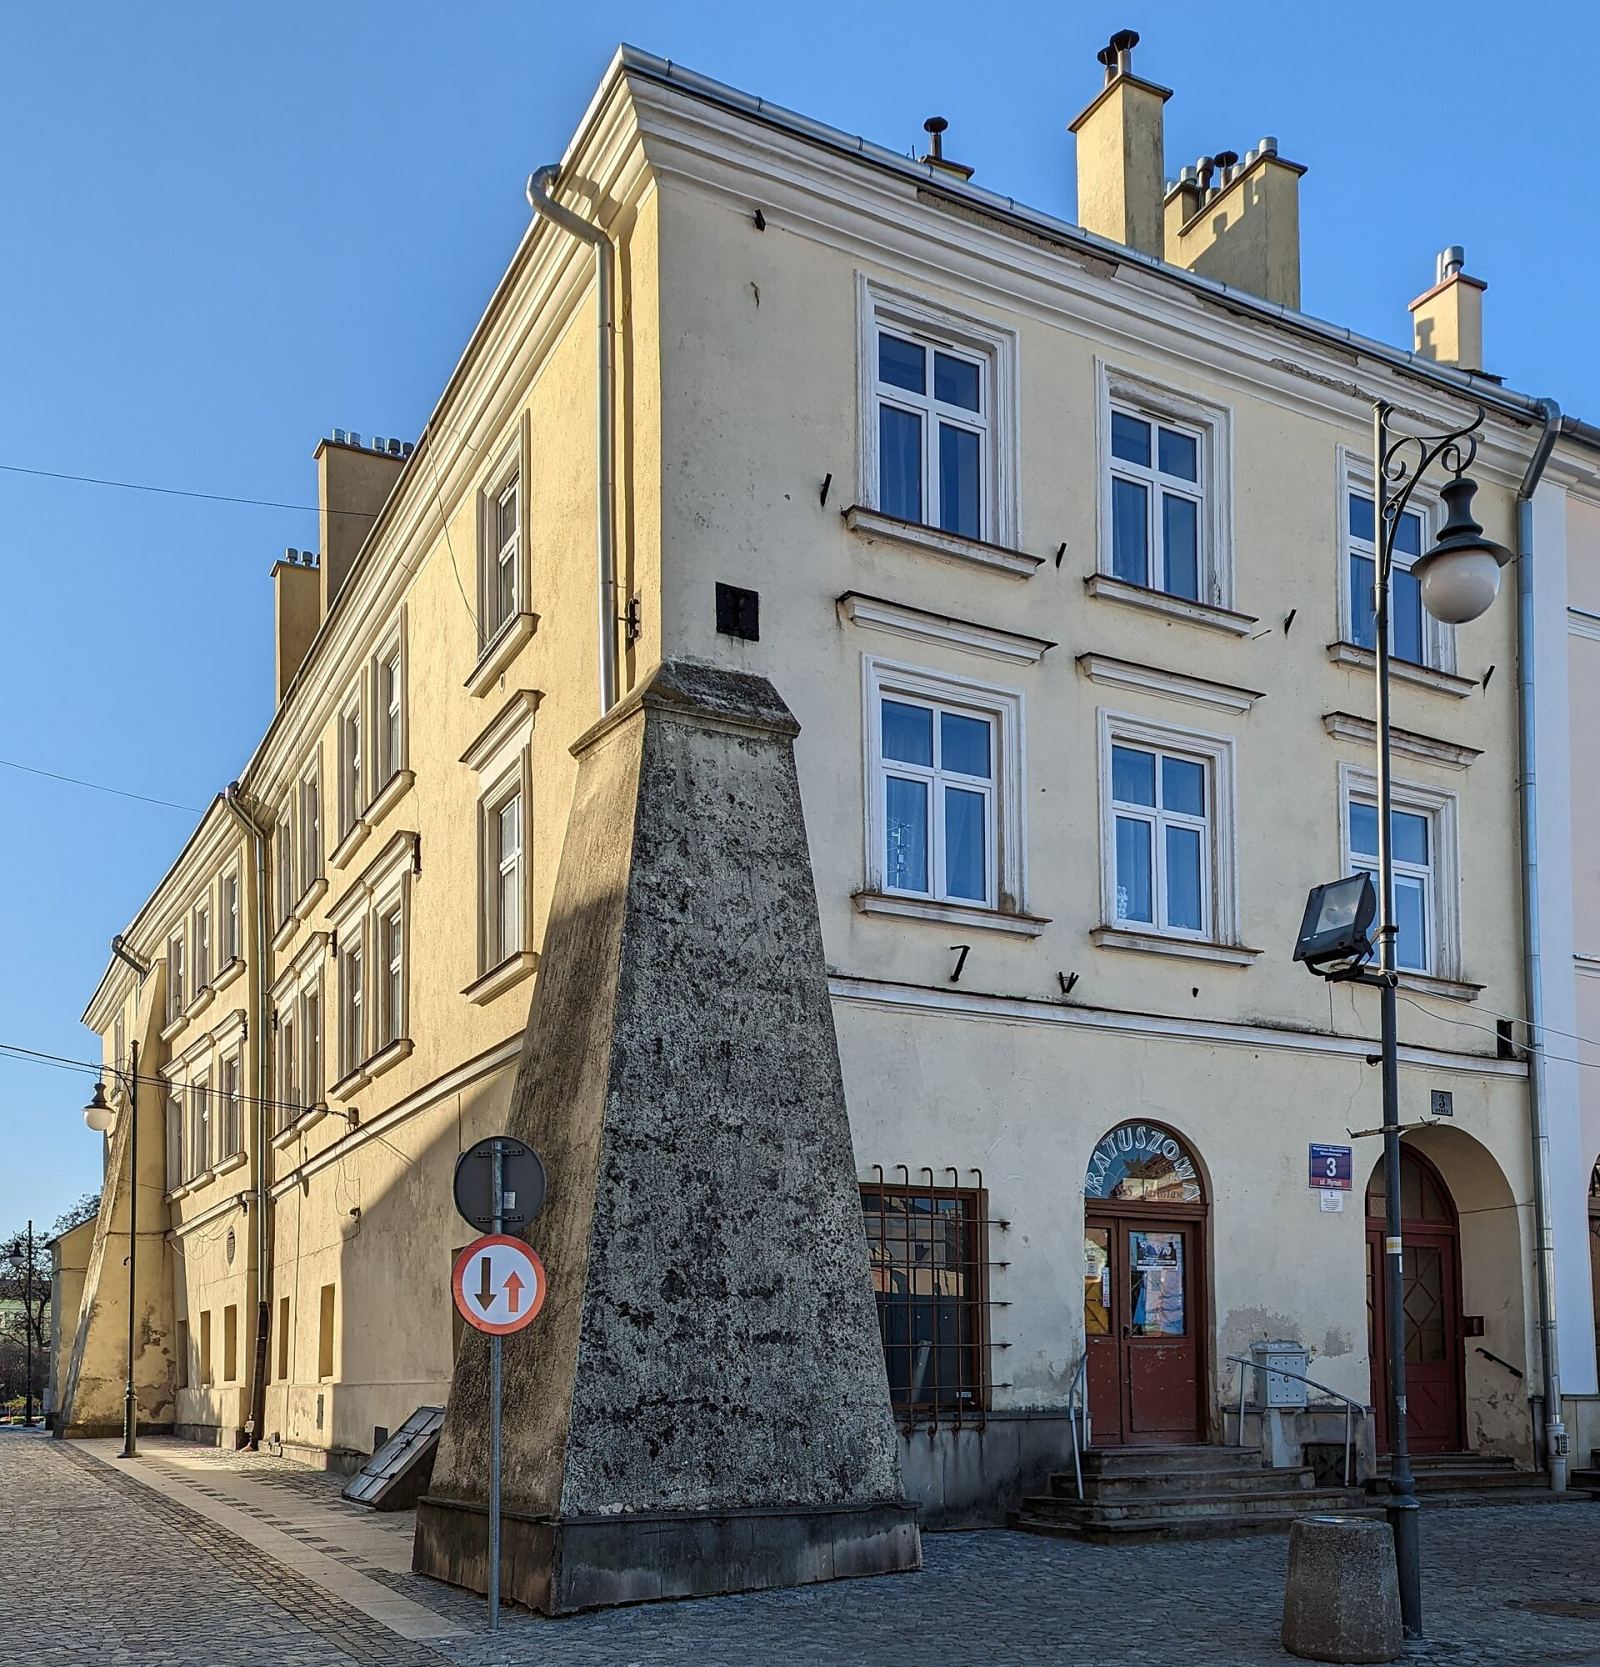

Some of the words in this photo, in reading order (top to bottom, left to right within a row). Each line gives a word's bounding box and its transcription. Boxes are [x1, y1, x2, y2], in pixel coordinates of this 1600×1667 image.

[1438, 1094, 1446, 1109] 3
[1085, 1125, 1201, 1201] RATUSZOWA
[1326, 1157, 1337, 1177] 3
[1327, 1179, 1343, 1188] Rynek
